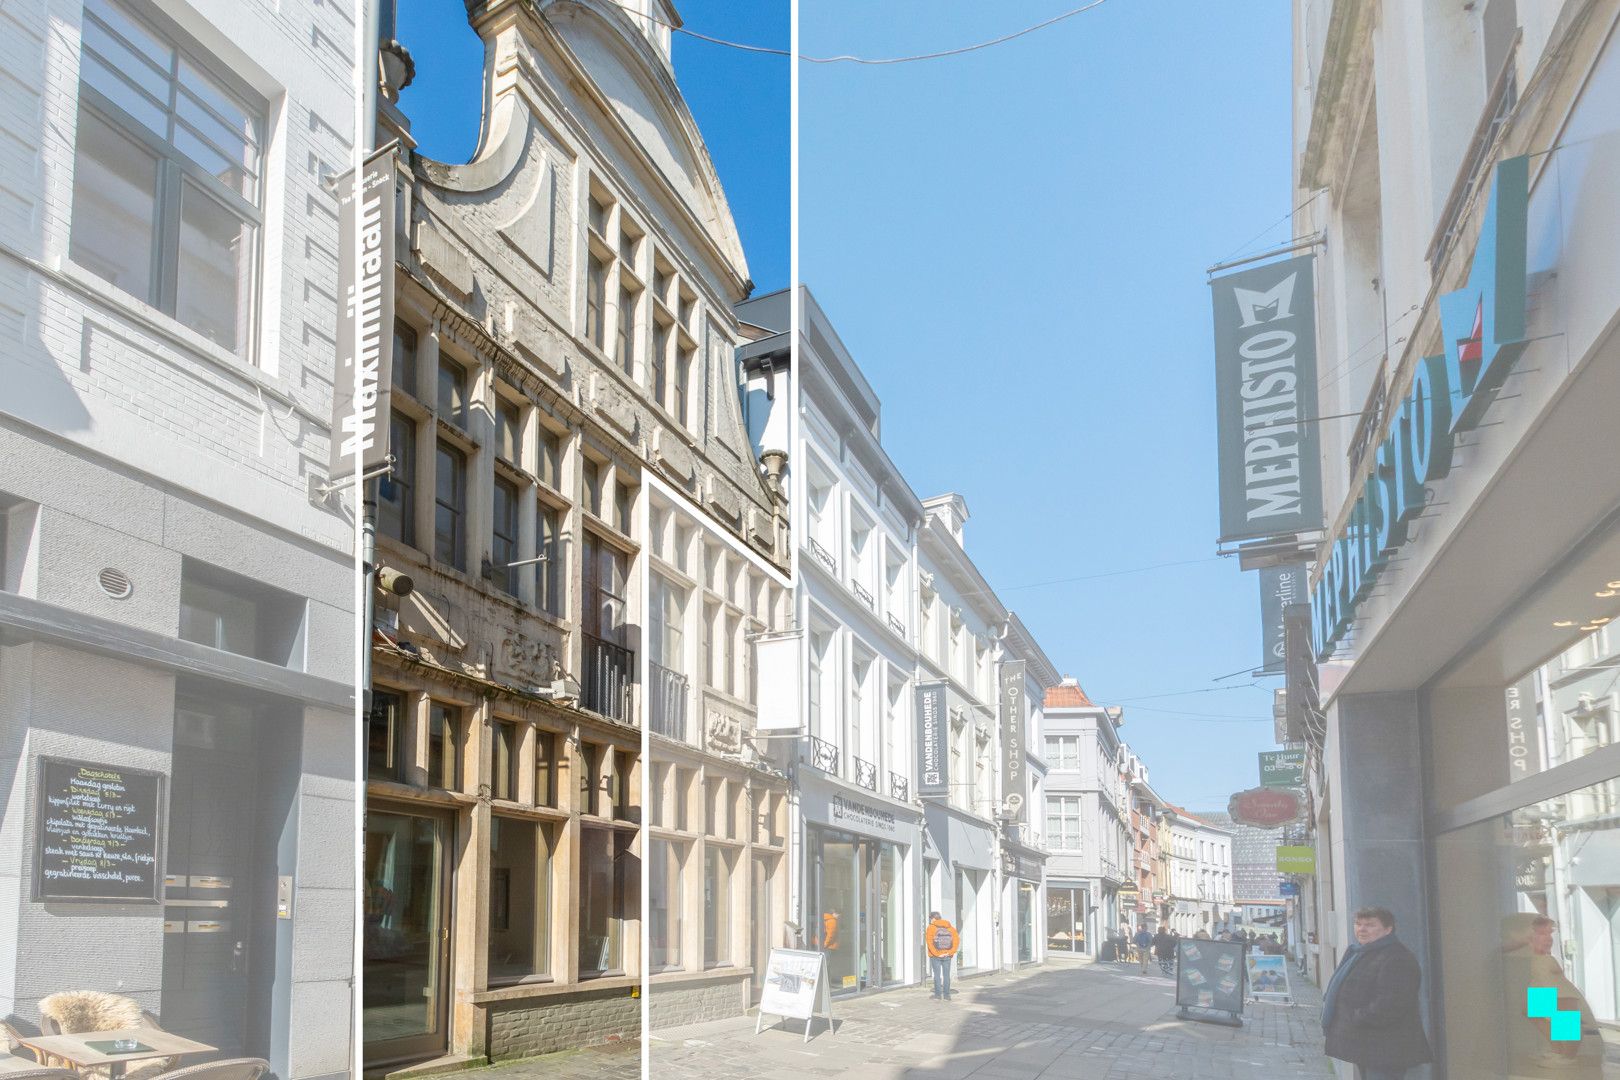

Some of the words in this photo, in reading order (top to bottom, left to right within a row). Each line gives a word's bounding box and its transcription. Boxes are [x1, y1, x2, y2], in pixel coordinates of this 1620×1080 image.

[1239, 330, 1302, 521] MEPHISTO
[1311, 355, 1438, 664] MEPHISTO
[1004, 672, 1021, 685] THE
[923, 691, 933, 771] VANDENBOUHEDE
[1007, 687, 1018, 733] OTHER
[1008, 738, 1020, 781] SHOP
[71, 779, 101, 790] Maandag
[102, 782, 125, 791] gesloten
[71, 786, 100, 797] Dinsdag
